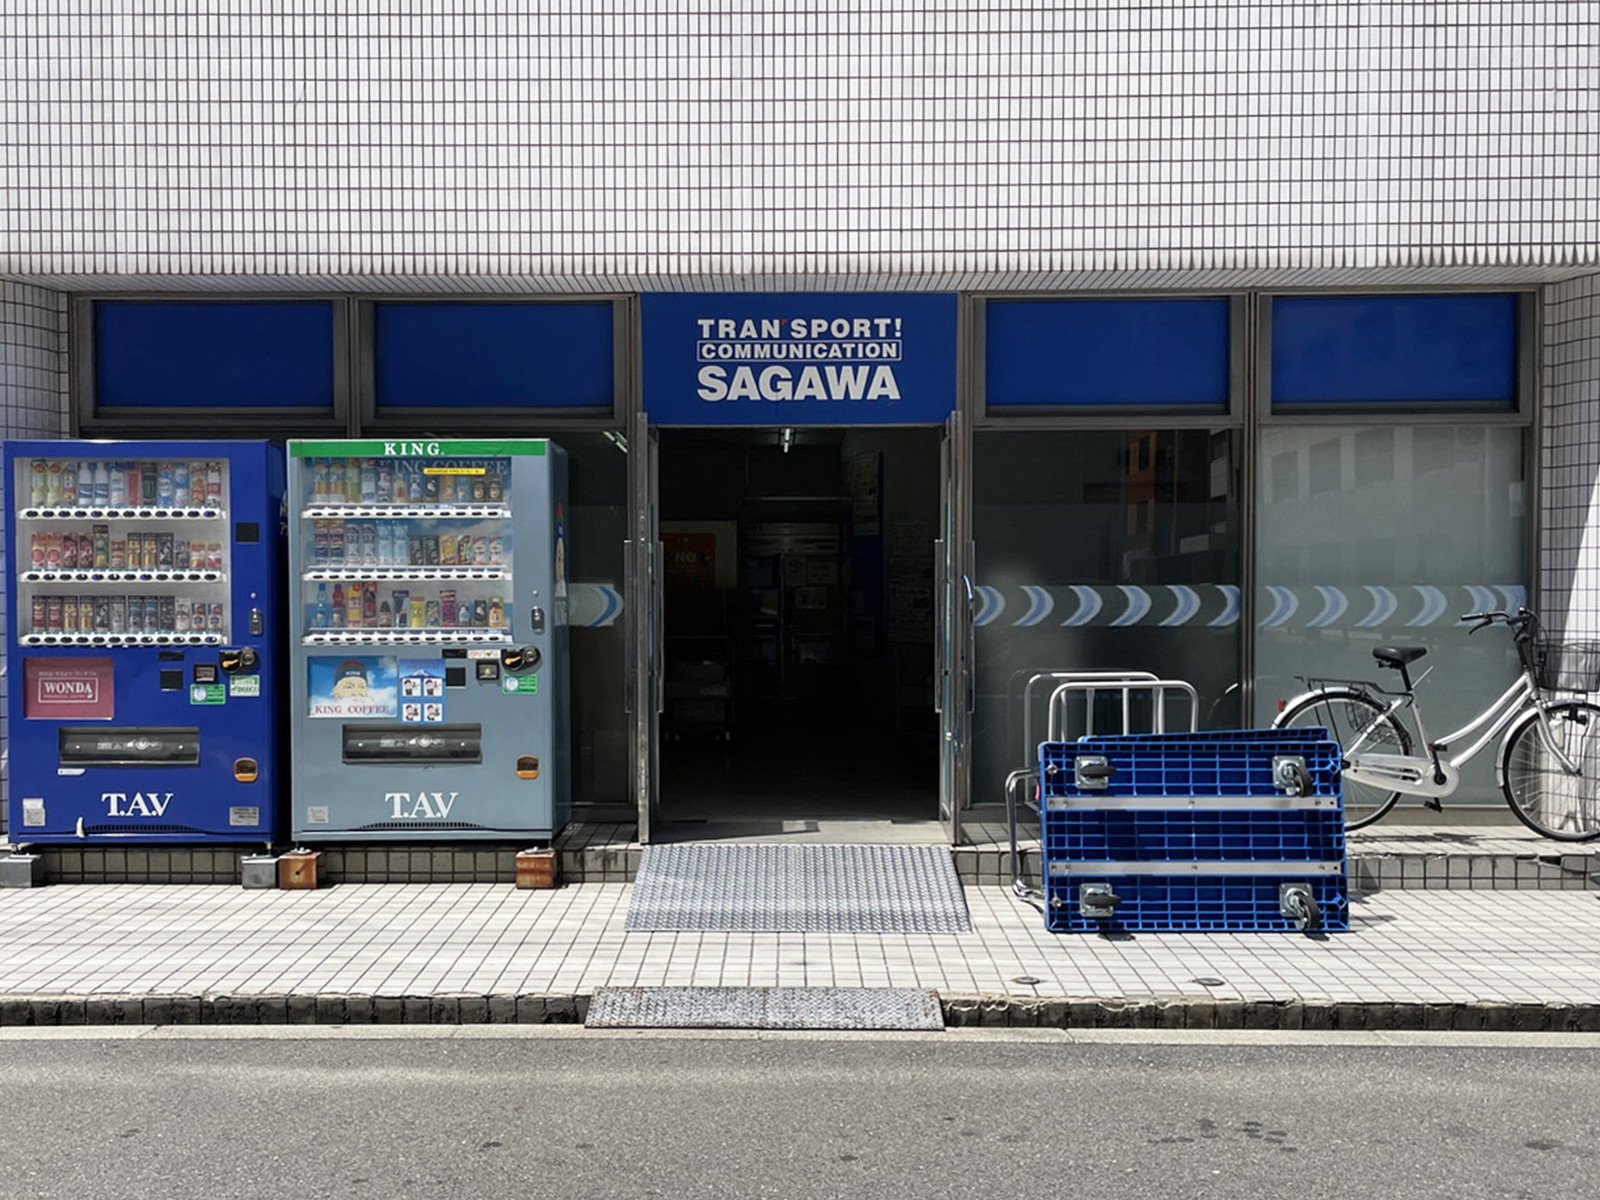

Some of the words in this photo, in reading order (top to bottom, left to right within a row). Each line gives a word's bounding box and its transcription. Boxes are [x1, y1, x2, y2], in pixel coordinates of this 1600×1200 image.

[701, 343, 897, 359] COMMUNICATION
[697, 365, 901, 401] SAGAWA
[44, 682, 93, 694] WONDA
[315, 705, 342, 714] KING
[348, 705, 390, 714] COFFEE
